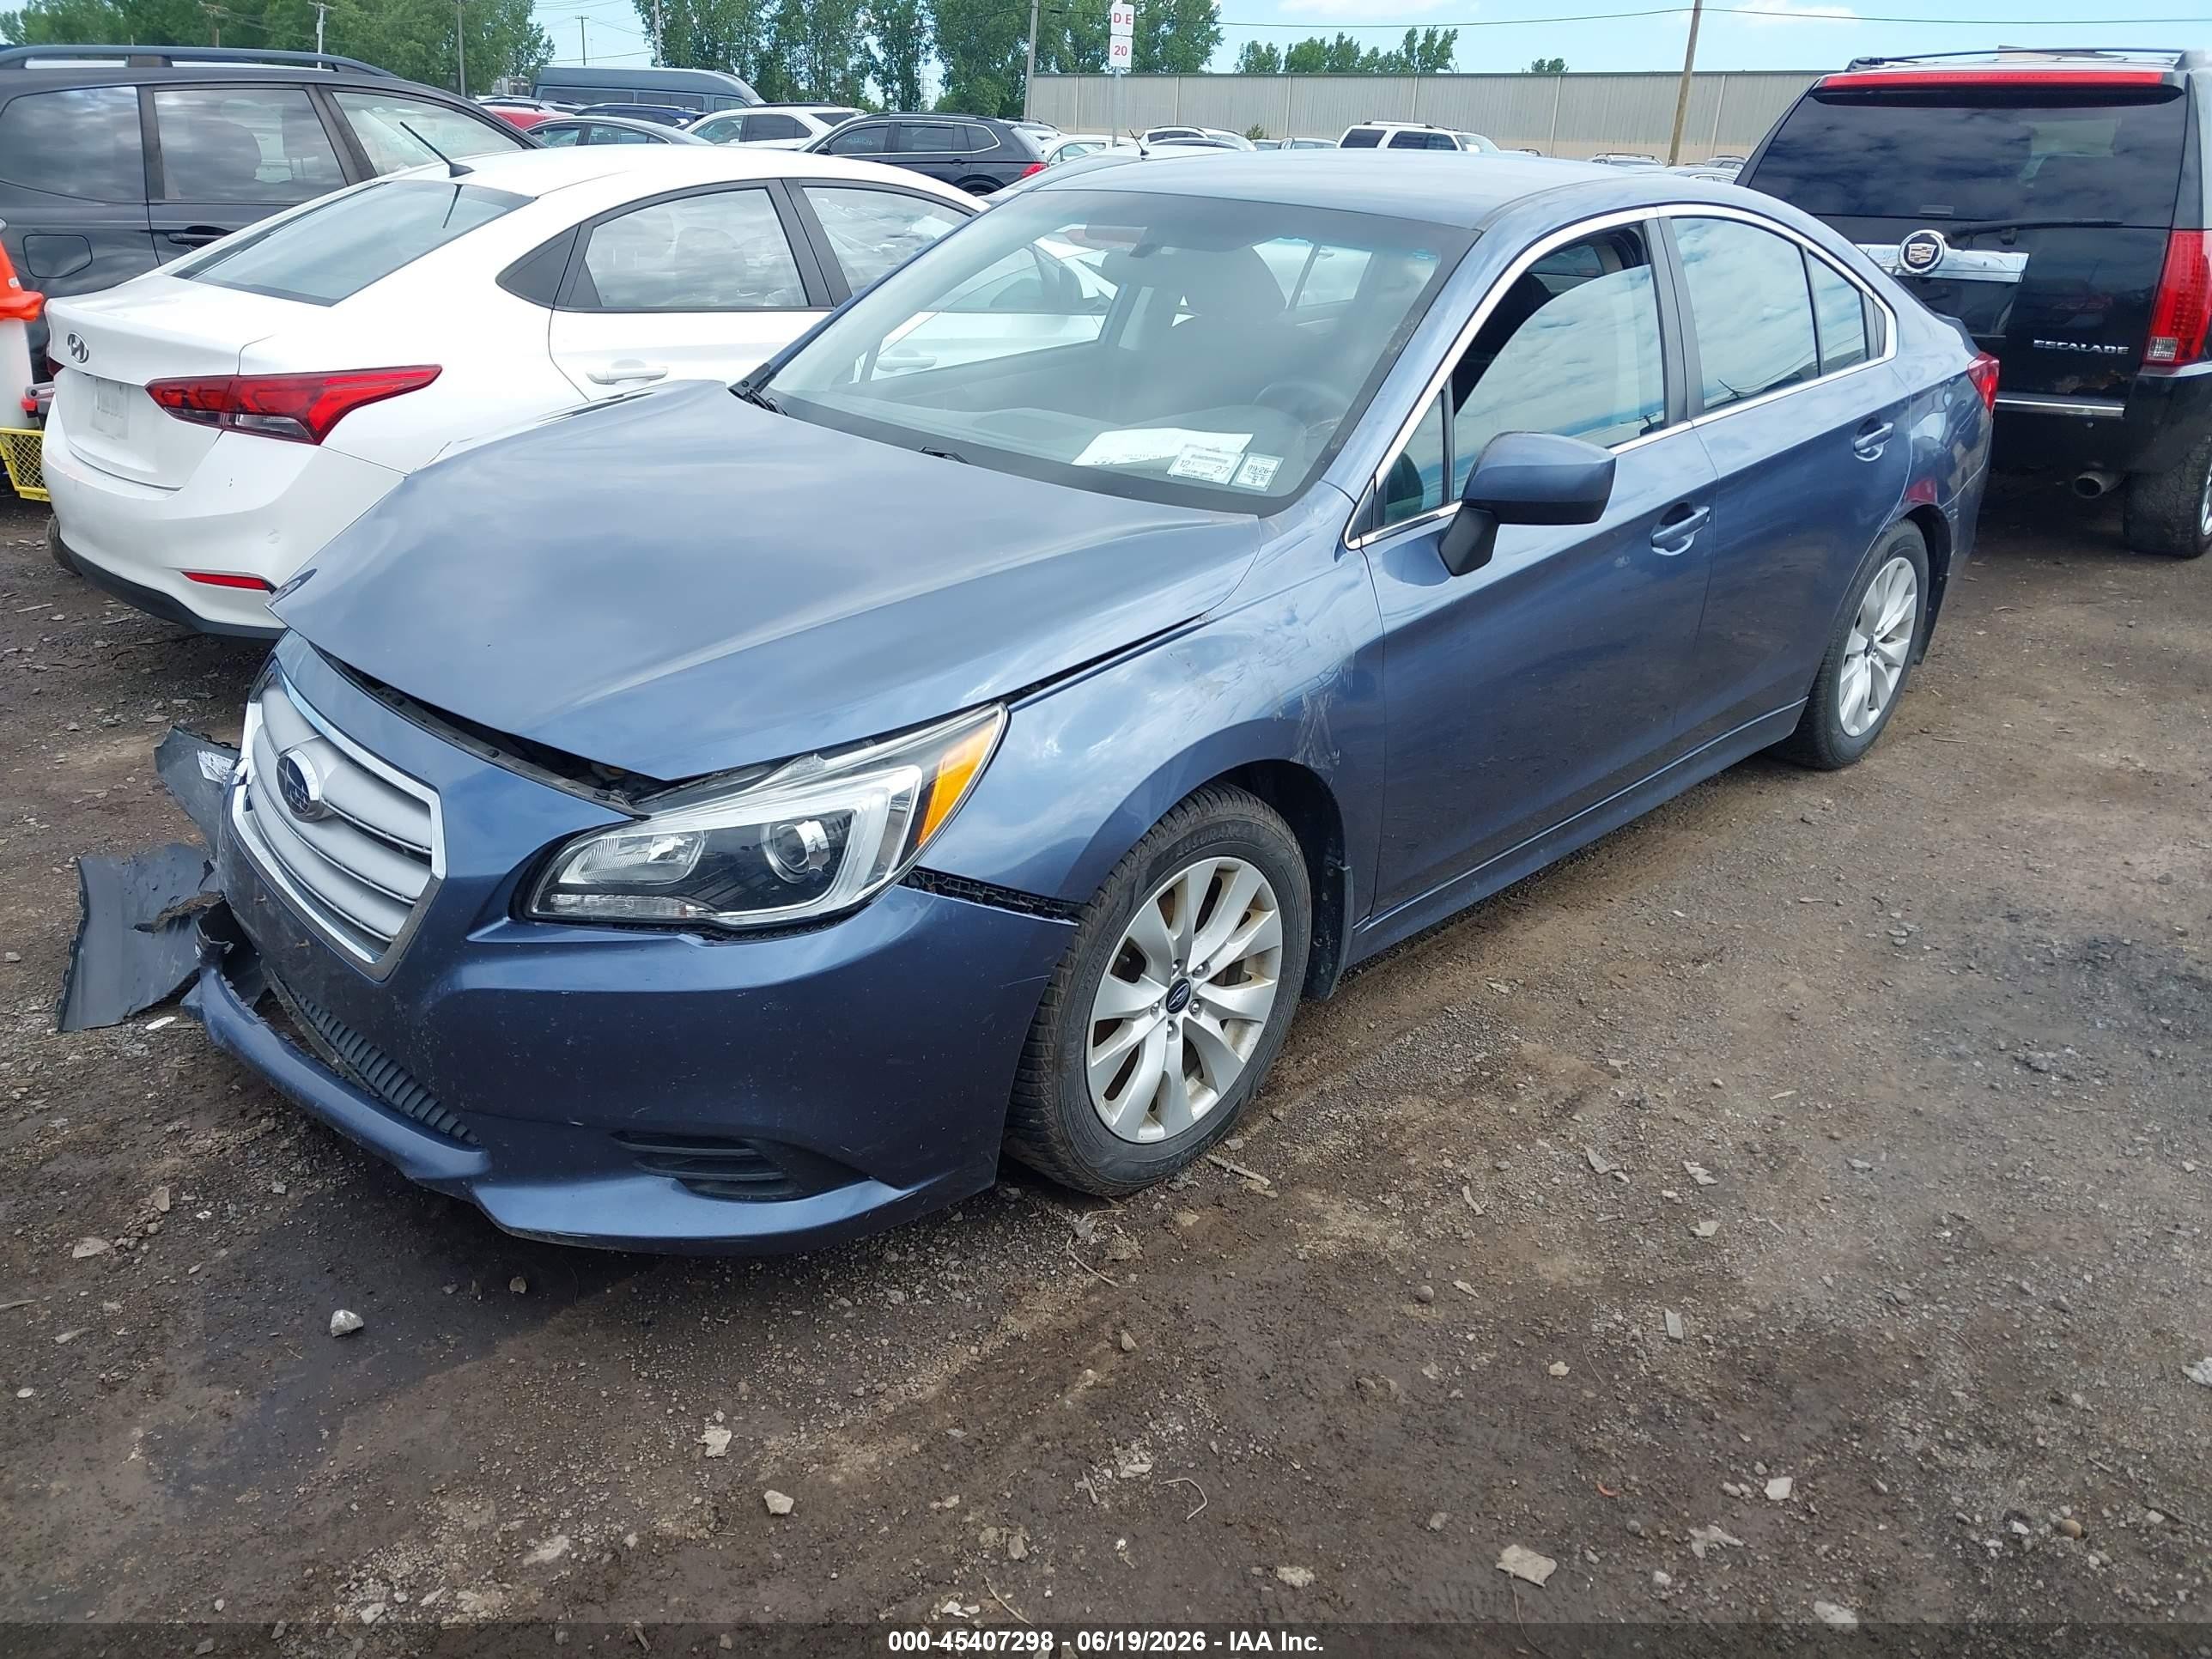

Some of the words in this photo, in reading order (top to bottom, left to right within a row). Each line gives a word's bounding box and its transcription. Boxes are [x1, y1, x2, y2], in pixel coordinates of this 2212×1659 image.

[1113, 13, 1121, 23] D
[1125, 14, 1132, 25] E
[1114, 46, 1127, 56] 20
[2033, 339, 2130, 355] ESCALADE
